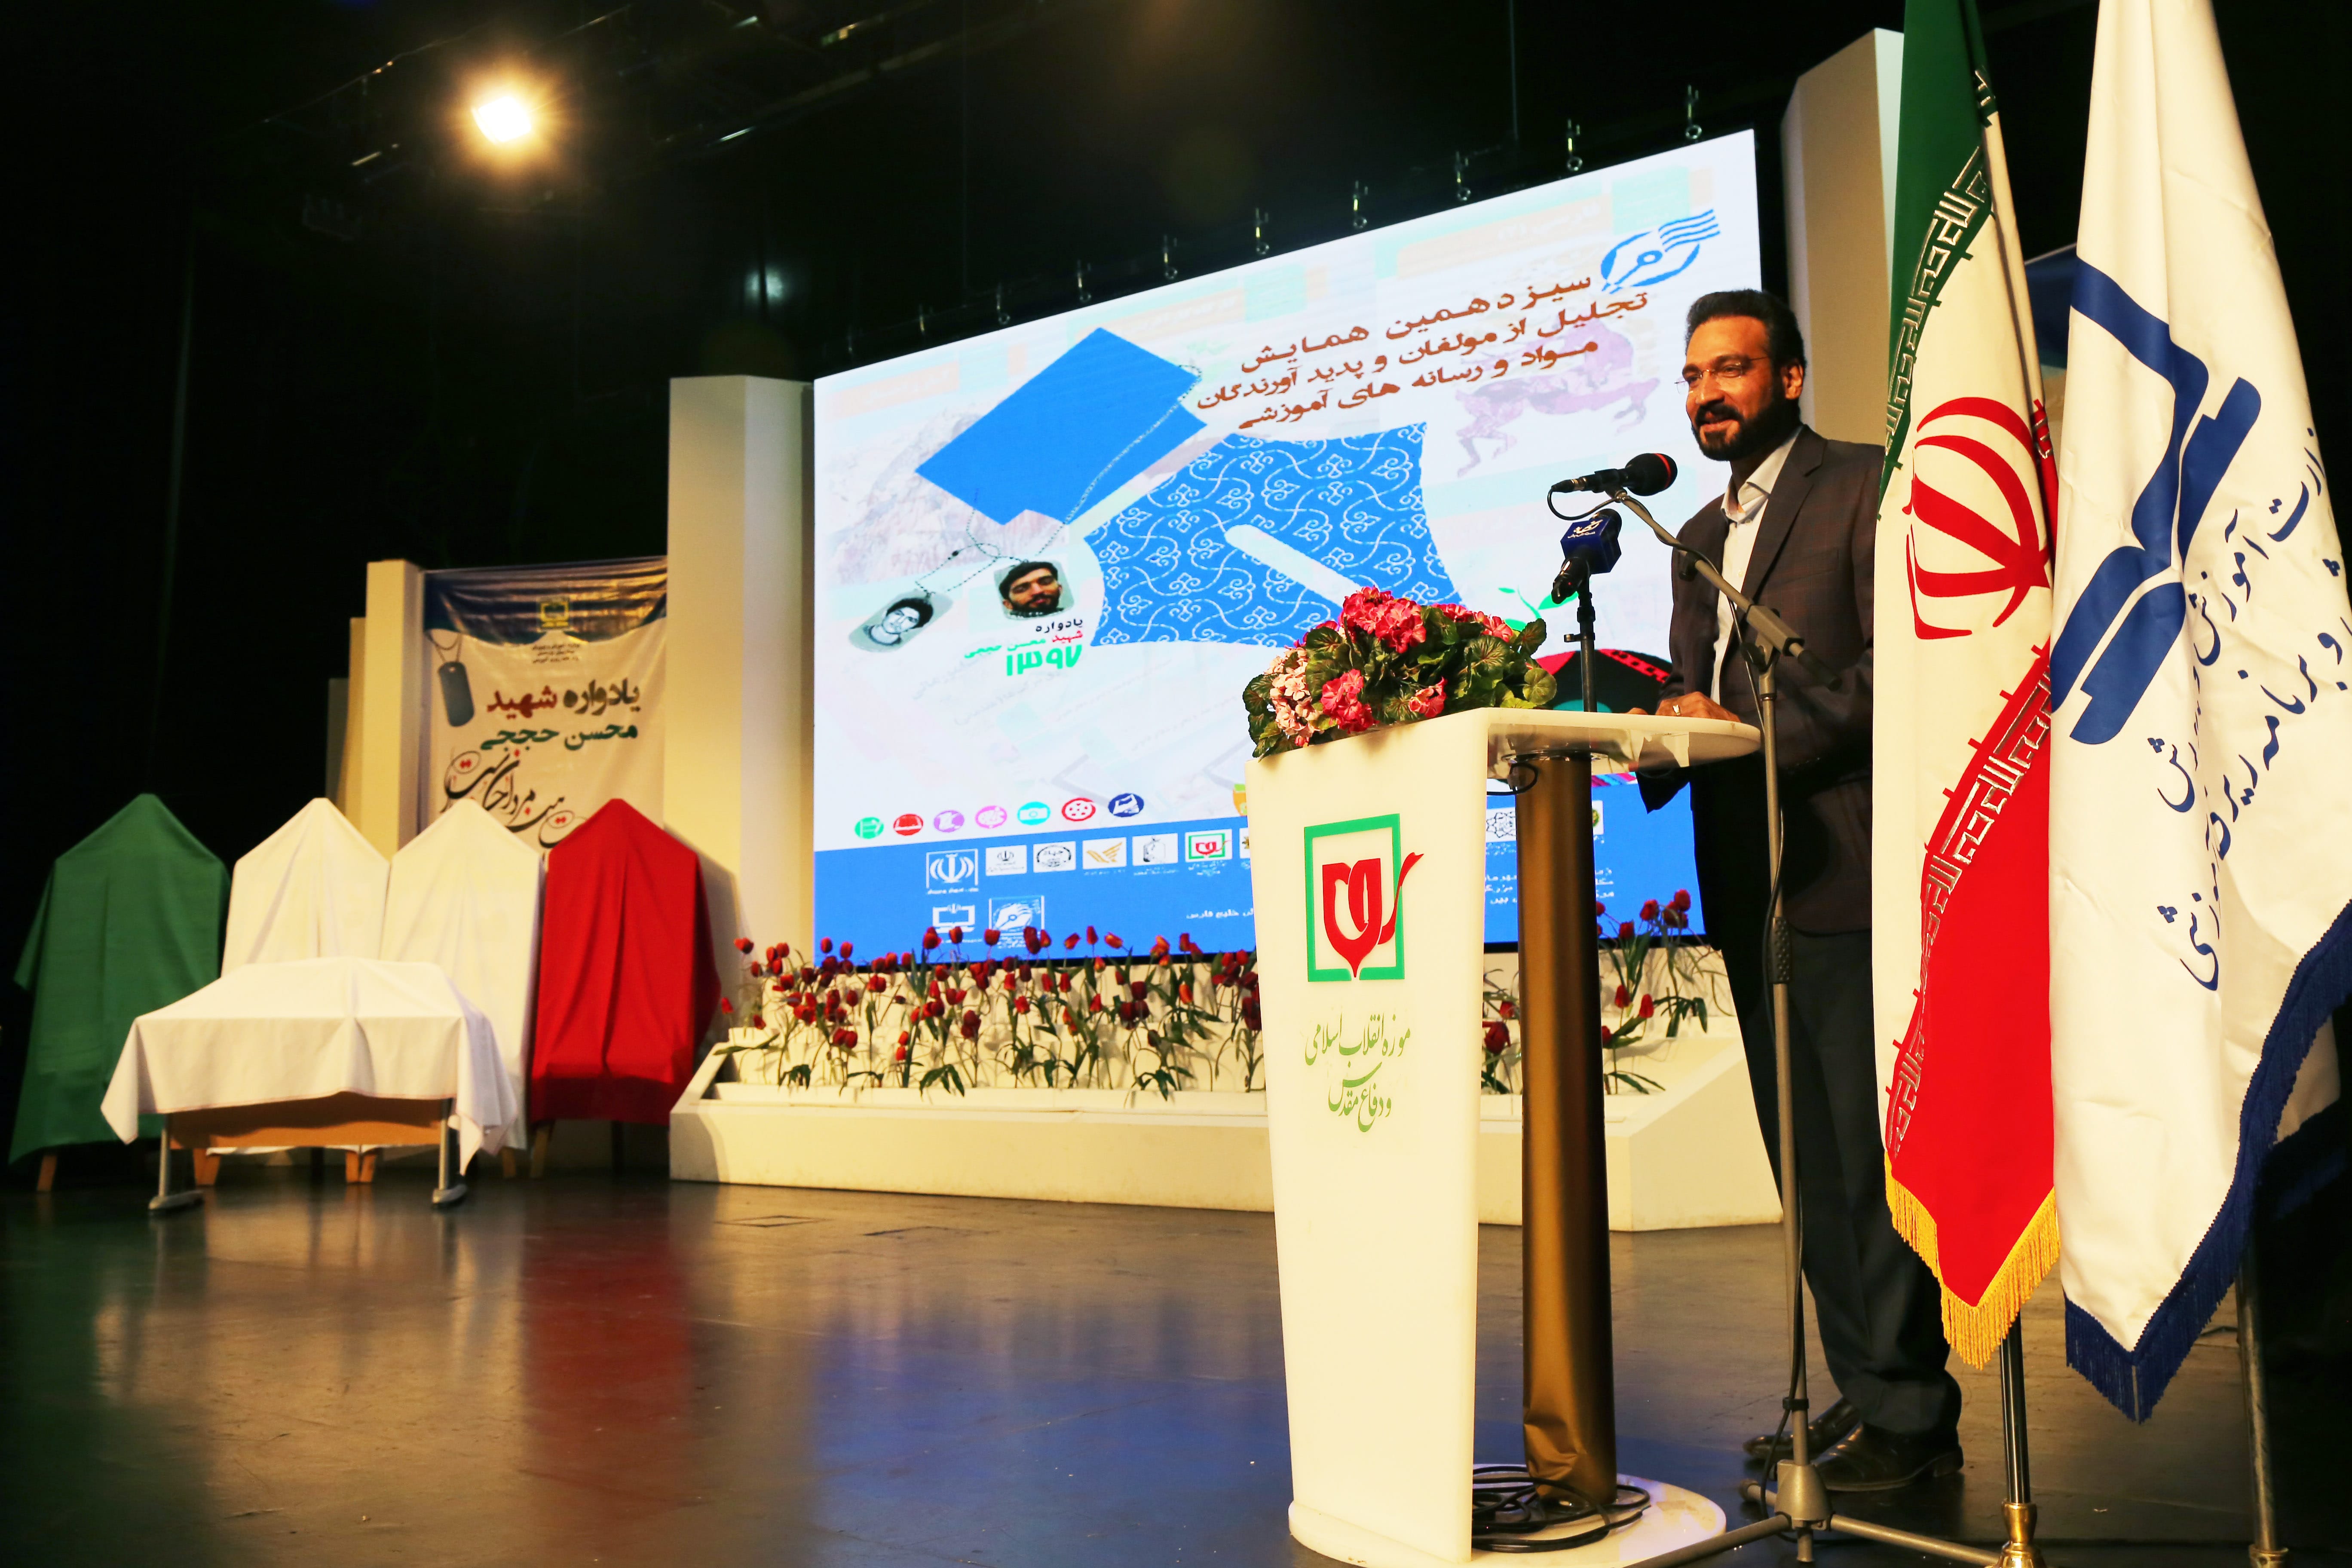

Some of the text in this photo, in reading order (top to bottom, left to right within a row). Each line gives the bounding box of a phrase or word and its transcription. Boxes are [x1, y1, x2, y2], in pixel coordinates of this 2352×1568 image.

[1197, 292, 1647, 409] تجلیل از مولفان و پدید آورندگان
[1241, 326, 1369, 373] همایش
[1239, 342, 1598, 429] مواد و رسانه های آموزشی
[2188, 508, 2269, 667] آموزش
[964, 630, 1083, 659] شهید محسن حججی
[1035, 619, 1083, 633] یادواره
[1006, 644, 1083, 677] ۱۳۹۷
[2317, 632, 2343, 665] و
[487, 678, 641, 719] یادواره شهید
[480, 723, 638, 752] محسن حججی
[1186, 910, 1213, 919] فارس
[1305, 1011, 1412, 1066] موزه انقلاب اسلامی
[1328, 1061, 1392, 1133] و دفاع مقدس
